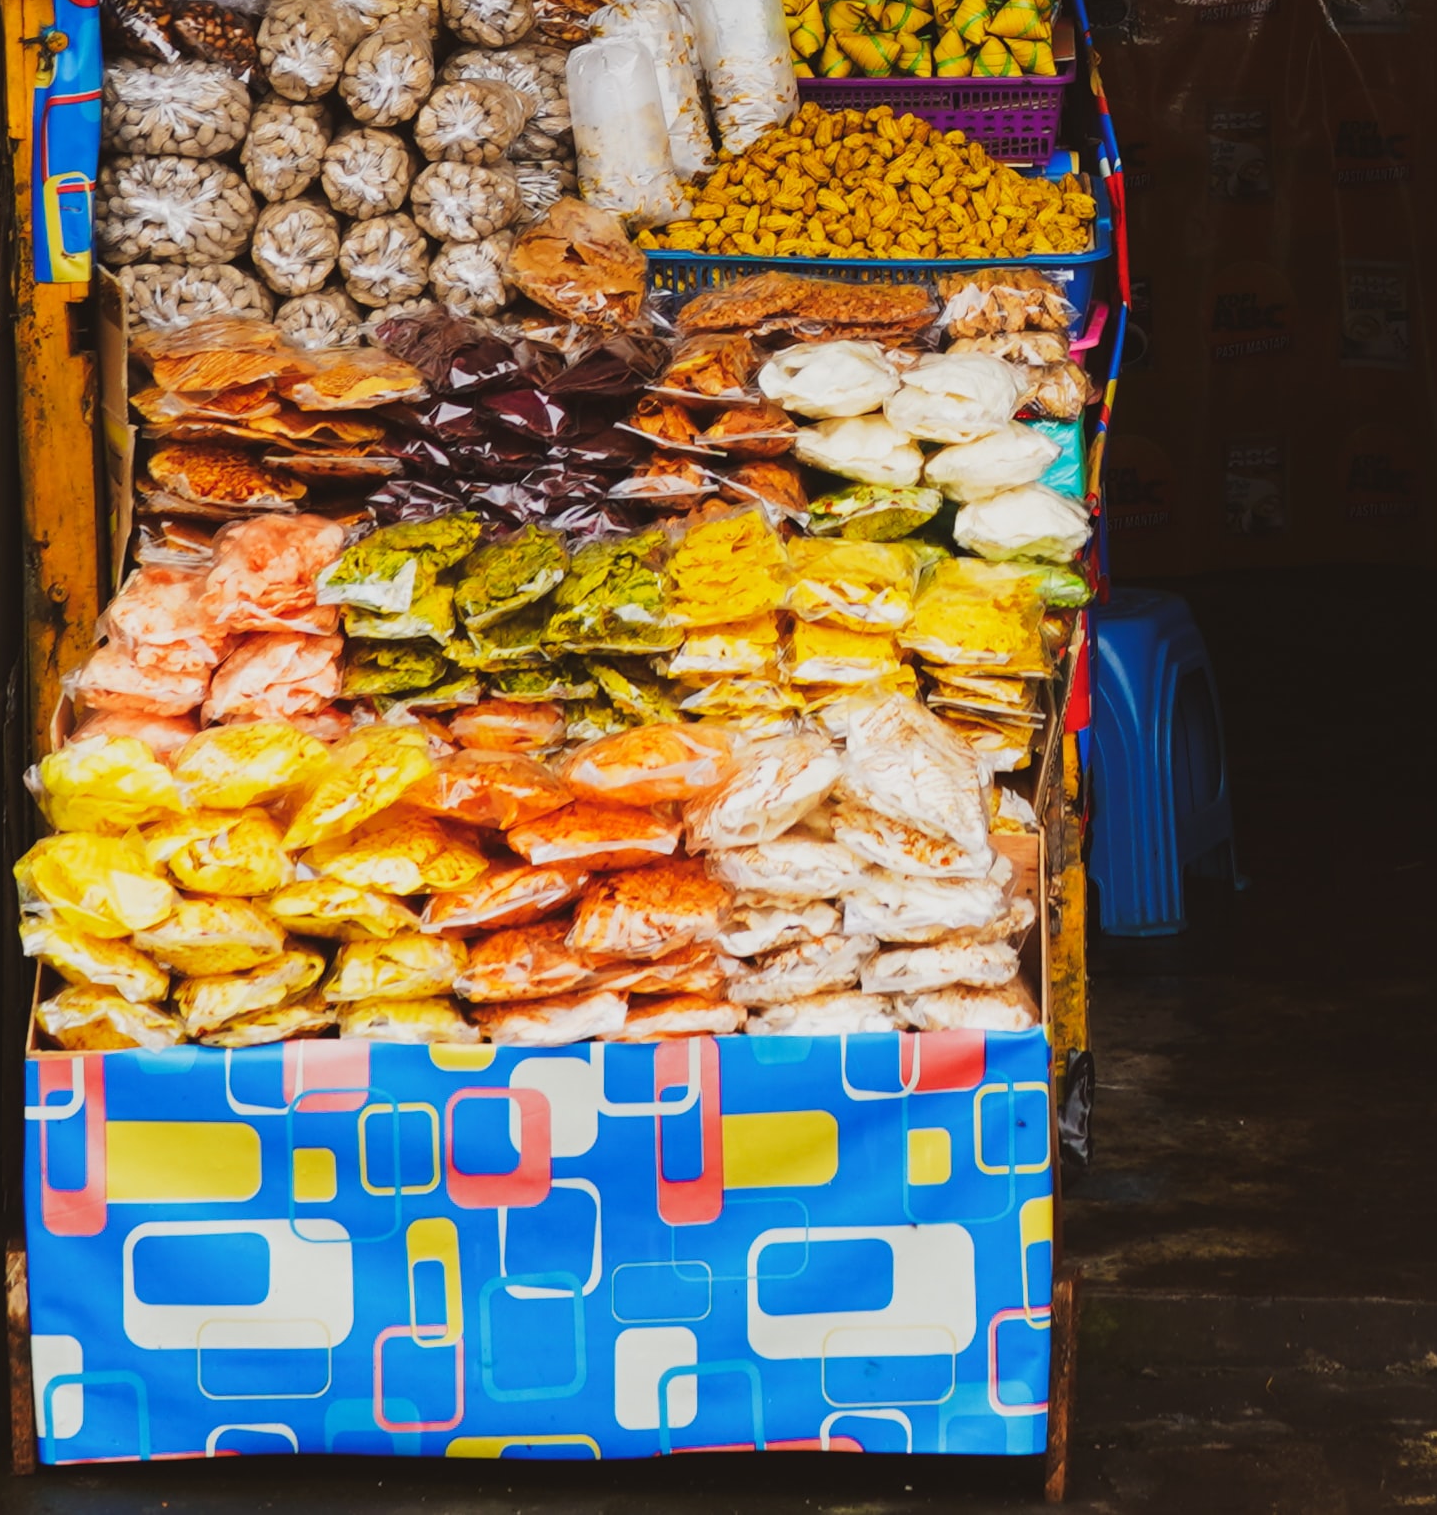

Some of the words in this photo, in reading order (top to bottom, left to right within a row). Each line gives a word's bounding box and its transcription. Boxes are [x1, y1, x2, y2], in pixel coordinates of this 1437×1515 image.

[1217, 294, 1257, 308] KOPI
[1212, 305, 1287, 331] ABC
[1216, 345, 1245, 358] PASTI
[1247, 337, 1290, 354] MANTAP!
